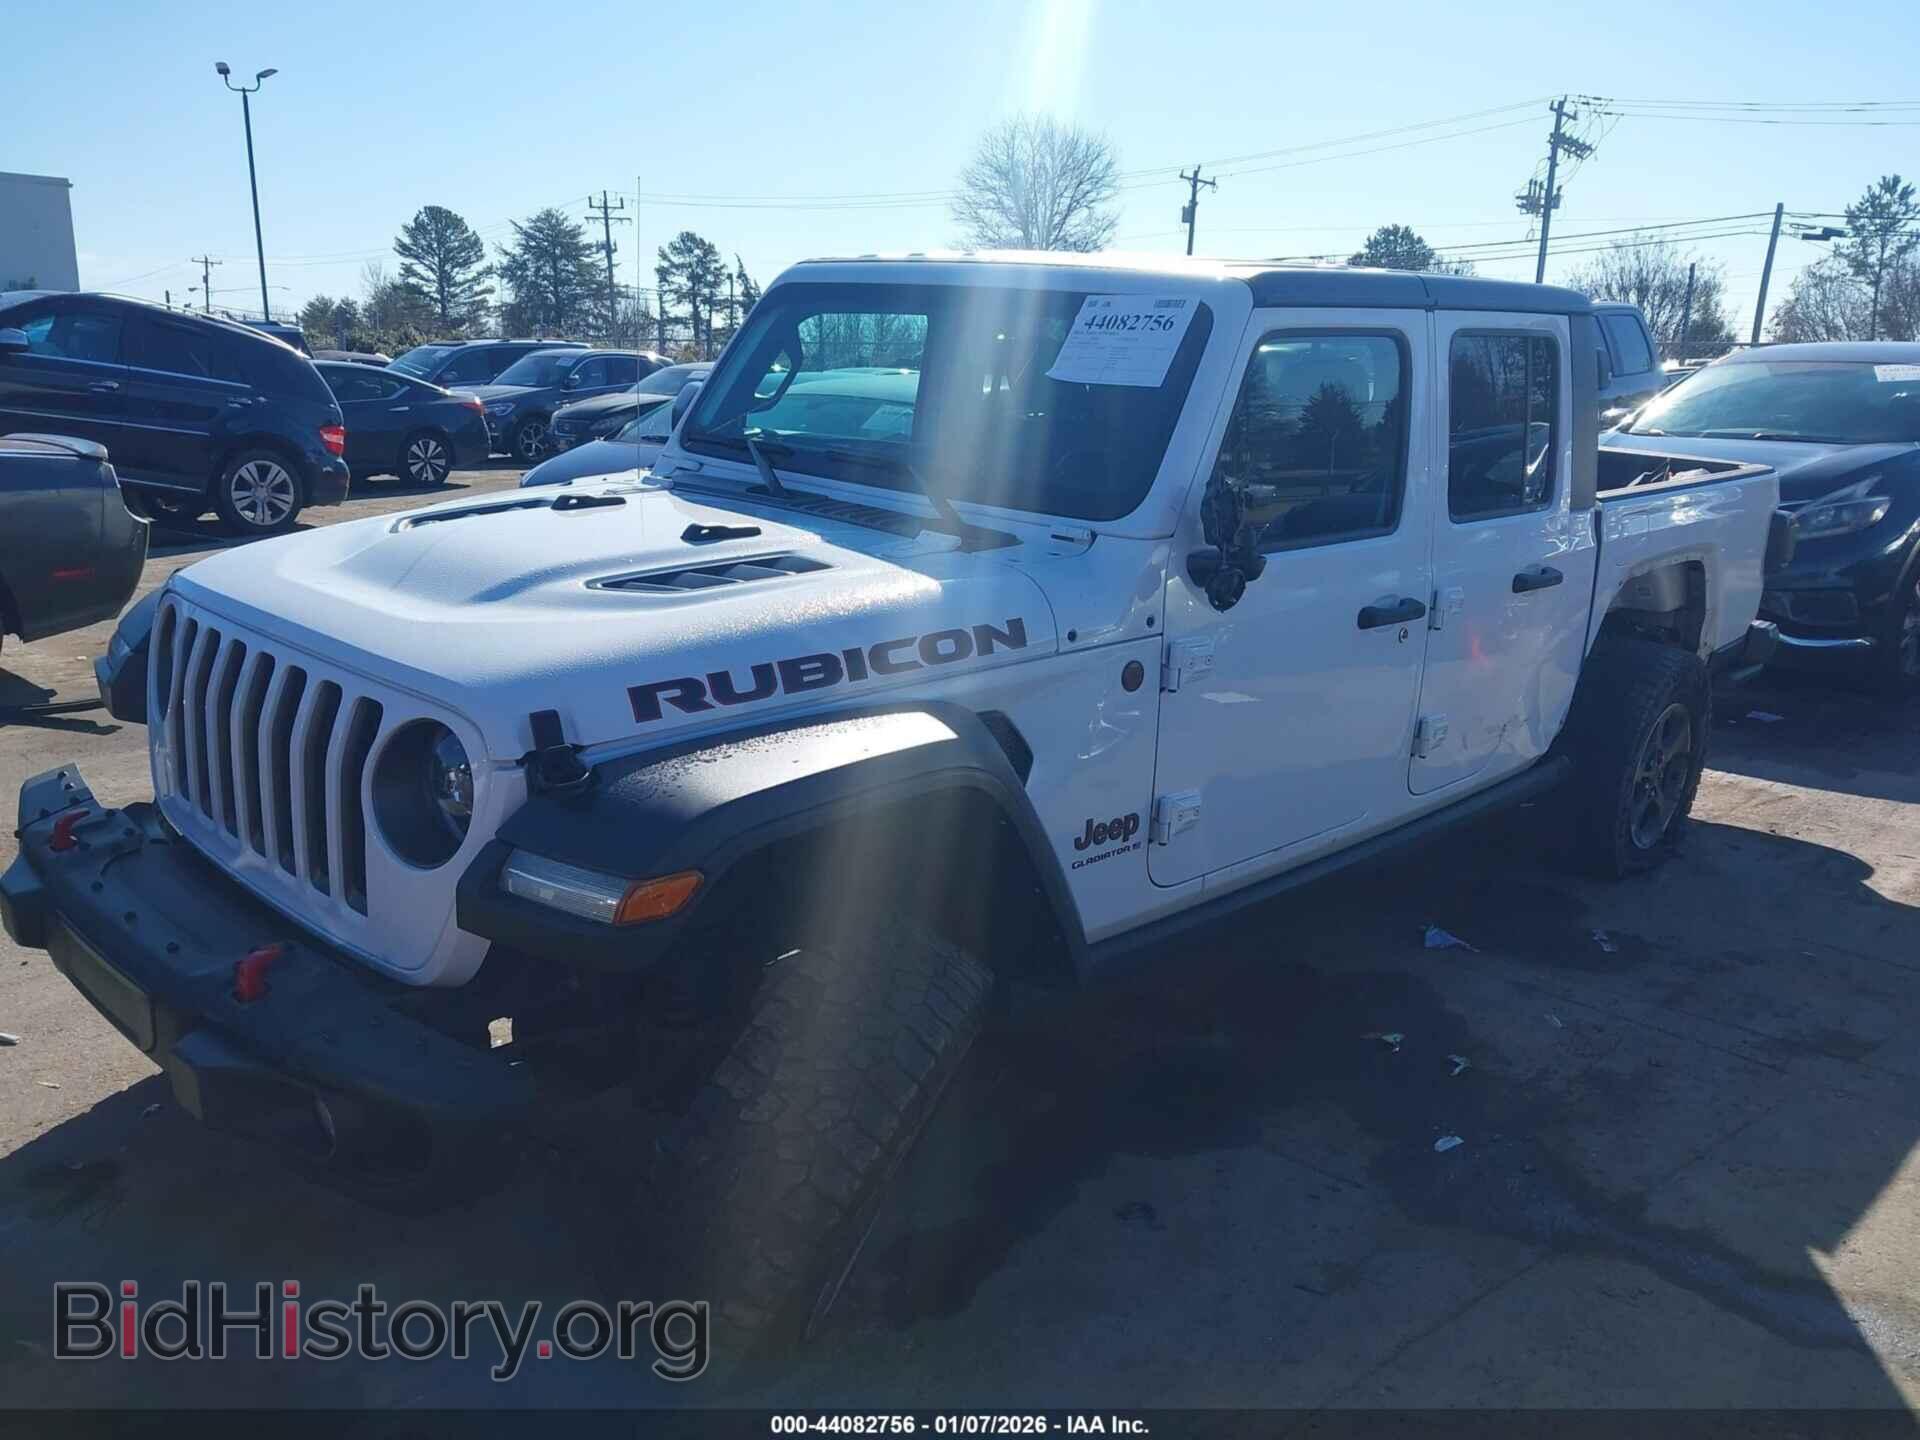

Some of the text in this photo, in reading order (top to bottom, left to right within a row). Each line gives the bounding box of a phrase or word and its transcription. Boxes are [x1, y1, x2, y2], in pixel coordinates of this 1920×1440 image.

[1084, 314, 1175, 331] 44082756
[626, 617, 1027, 723] RUBICON
[1074, 812, 1140, 851] Jeep
[1071, 845, 1131, 870] GLADIATOR
